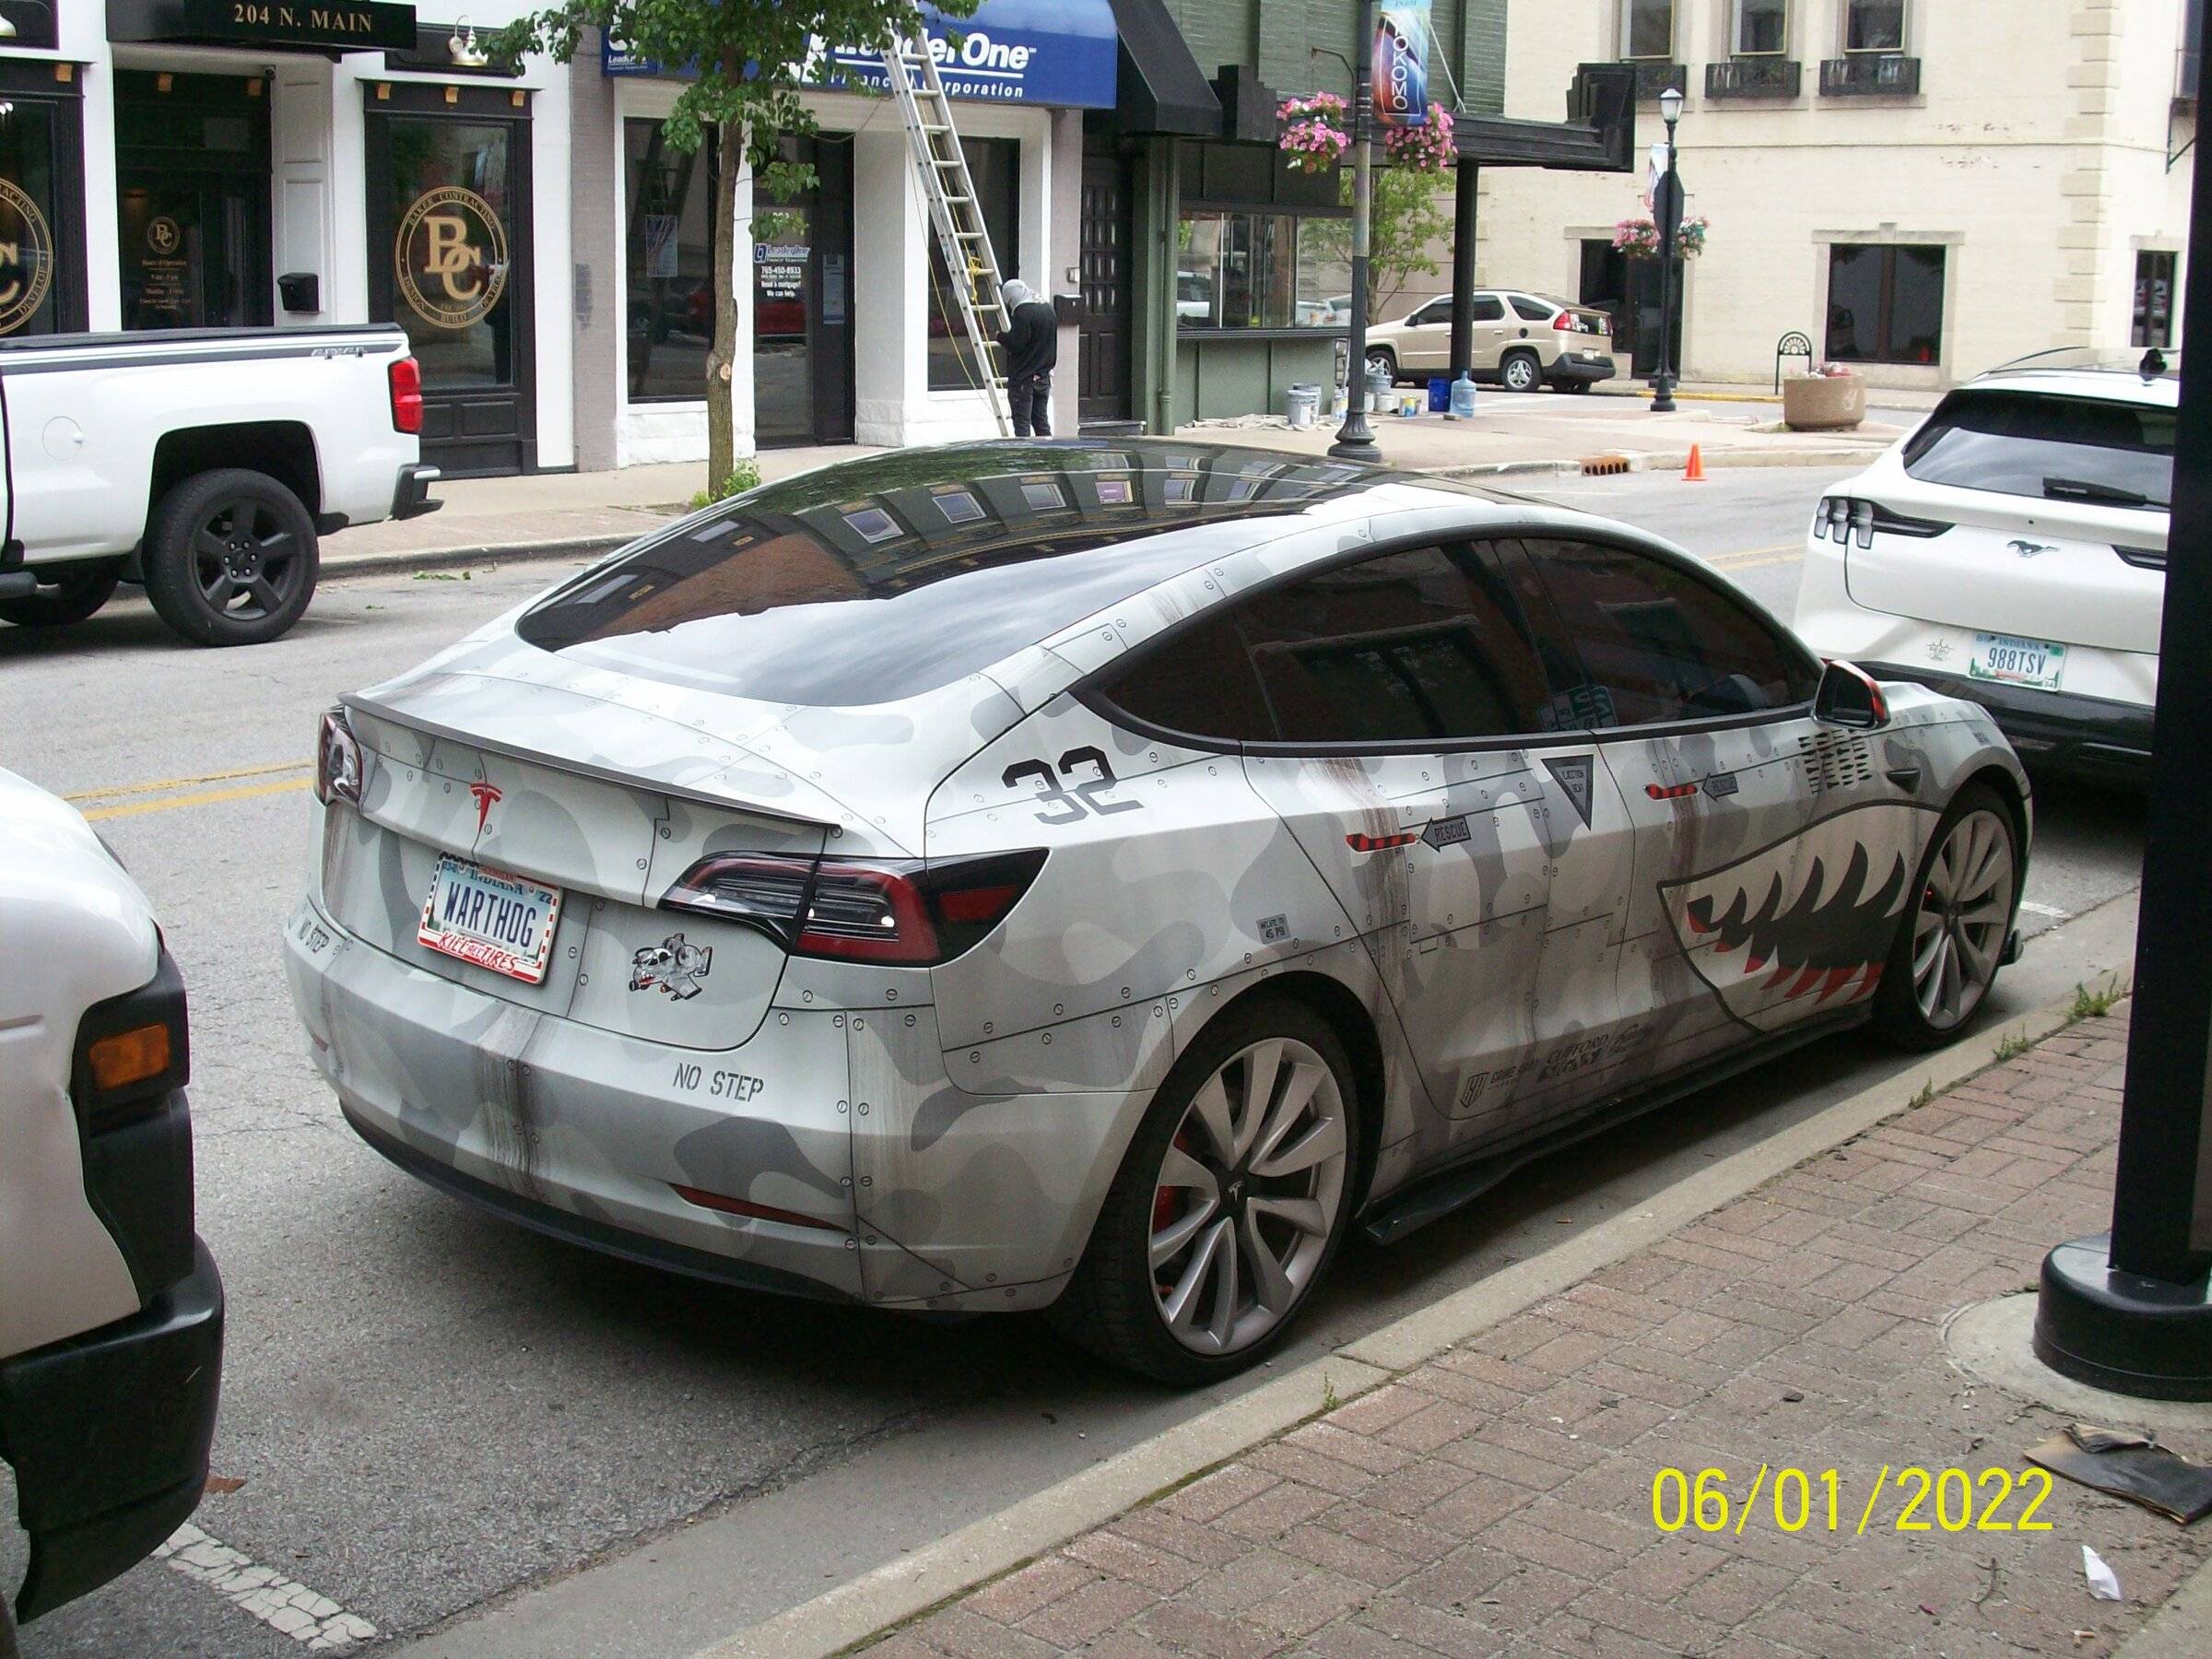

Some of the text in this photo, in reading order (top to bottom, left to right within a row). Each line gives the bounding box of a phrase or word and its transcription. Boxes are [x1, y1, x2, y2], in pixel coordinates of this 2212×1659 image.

[234, 4, 371, 32] 204 N. MAIN
[922, 80, 1023, 98] rporation
[0, 186, 38, 224] ACTING
[1997, 635, 2041, 651] INDIANA
[1987, 647, 2047, 676] 988TSV
[1001, 745, 1145, 825] 32
[1434, 821, 1468, 842] RESCUE
[538, 890, 553, 904] 22
[443, 881, 536, 947] WARTHOG
[672, 1062, 764, 1102] NO STEP
